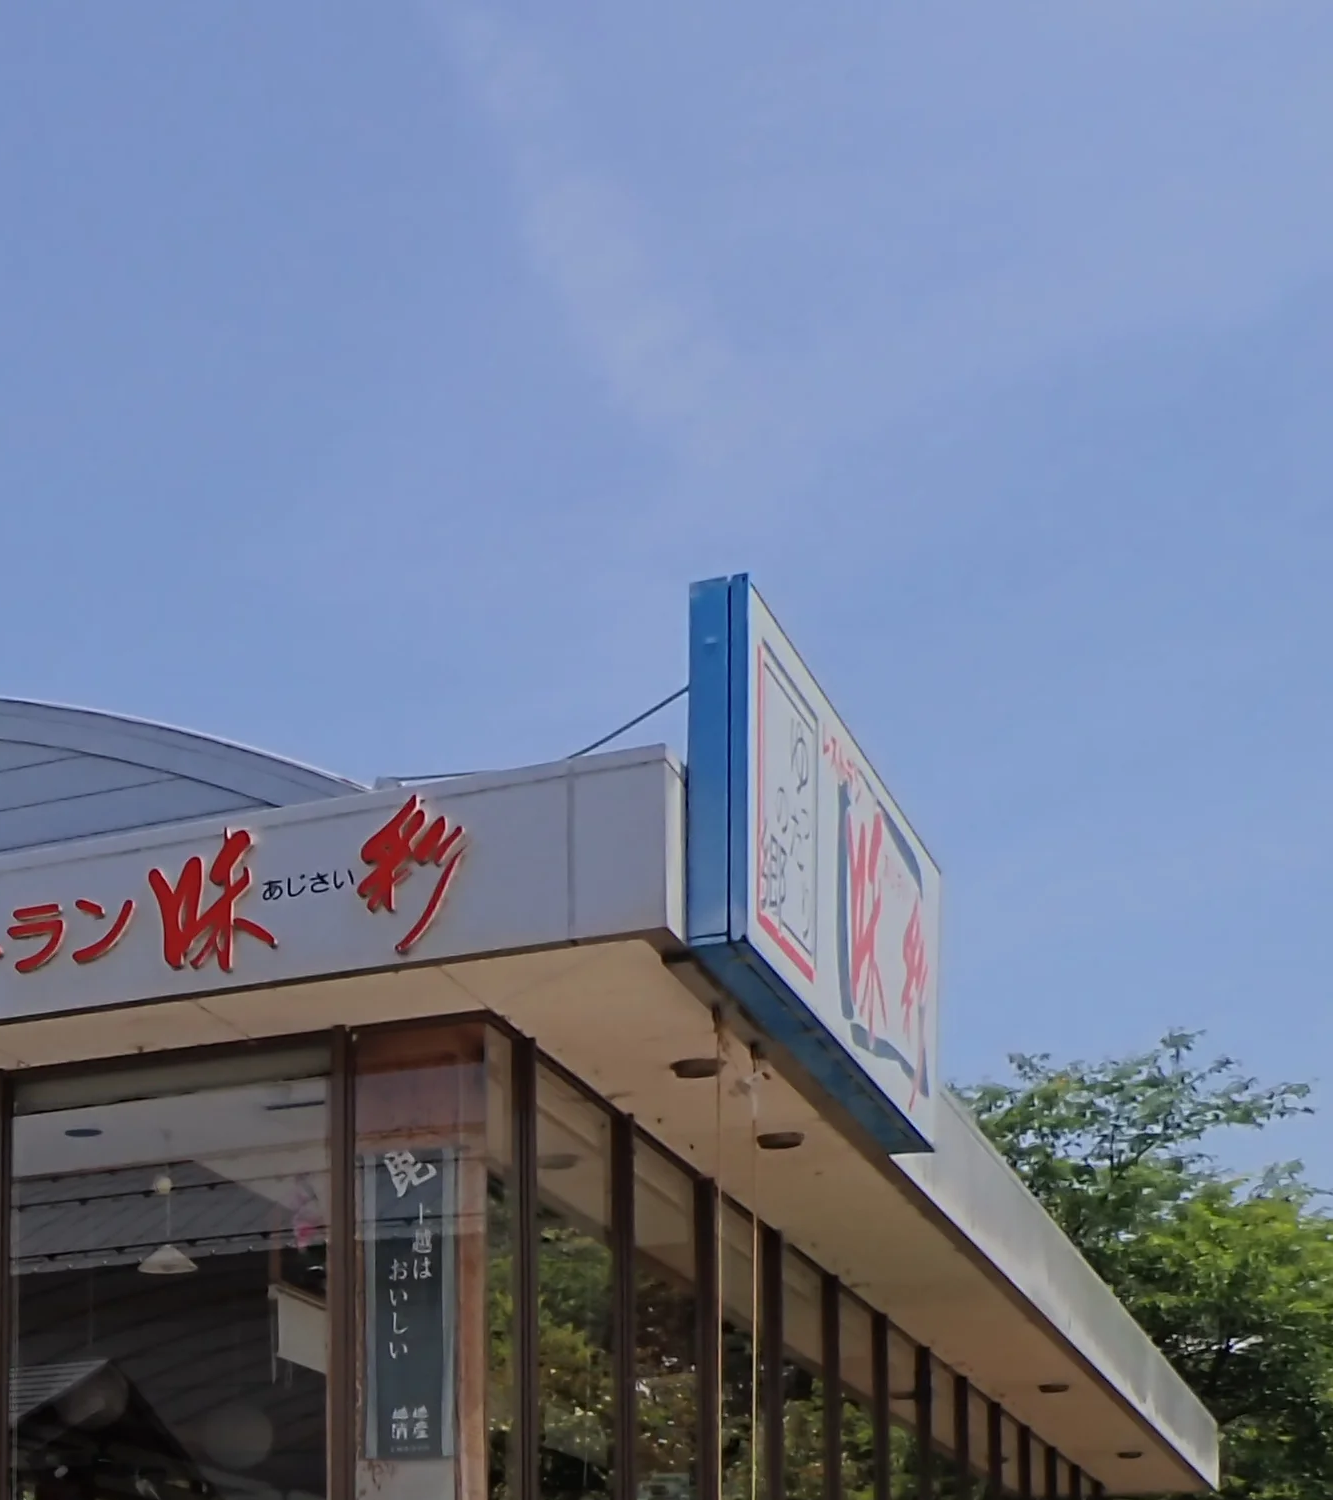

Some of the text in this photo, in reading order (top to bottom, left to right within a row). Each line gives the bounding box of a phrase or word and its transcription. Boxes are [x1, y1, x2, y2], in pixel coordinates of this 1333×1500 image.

[262, 867, 355, 901] あじさい
[388, 1258, 409, 1361] おいしい
